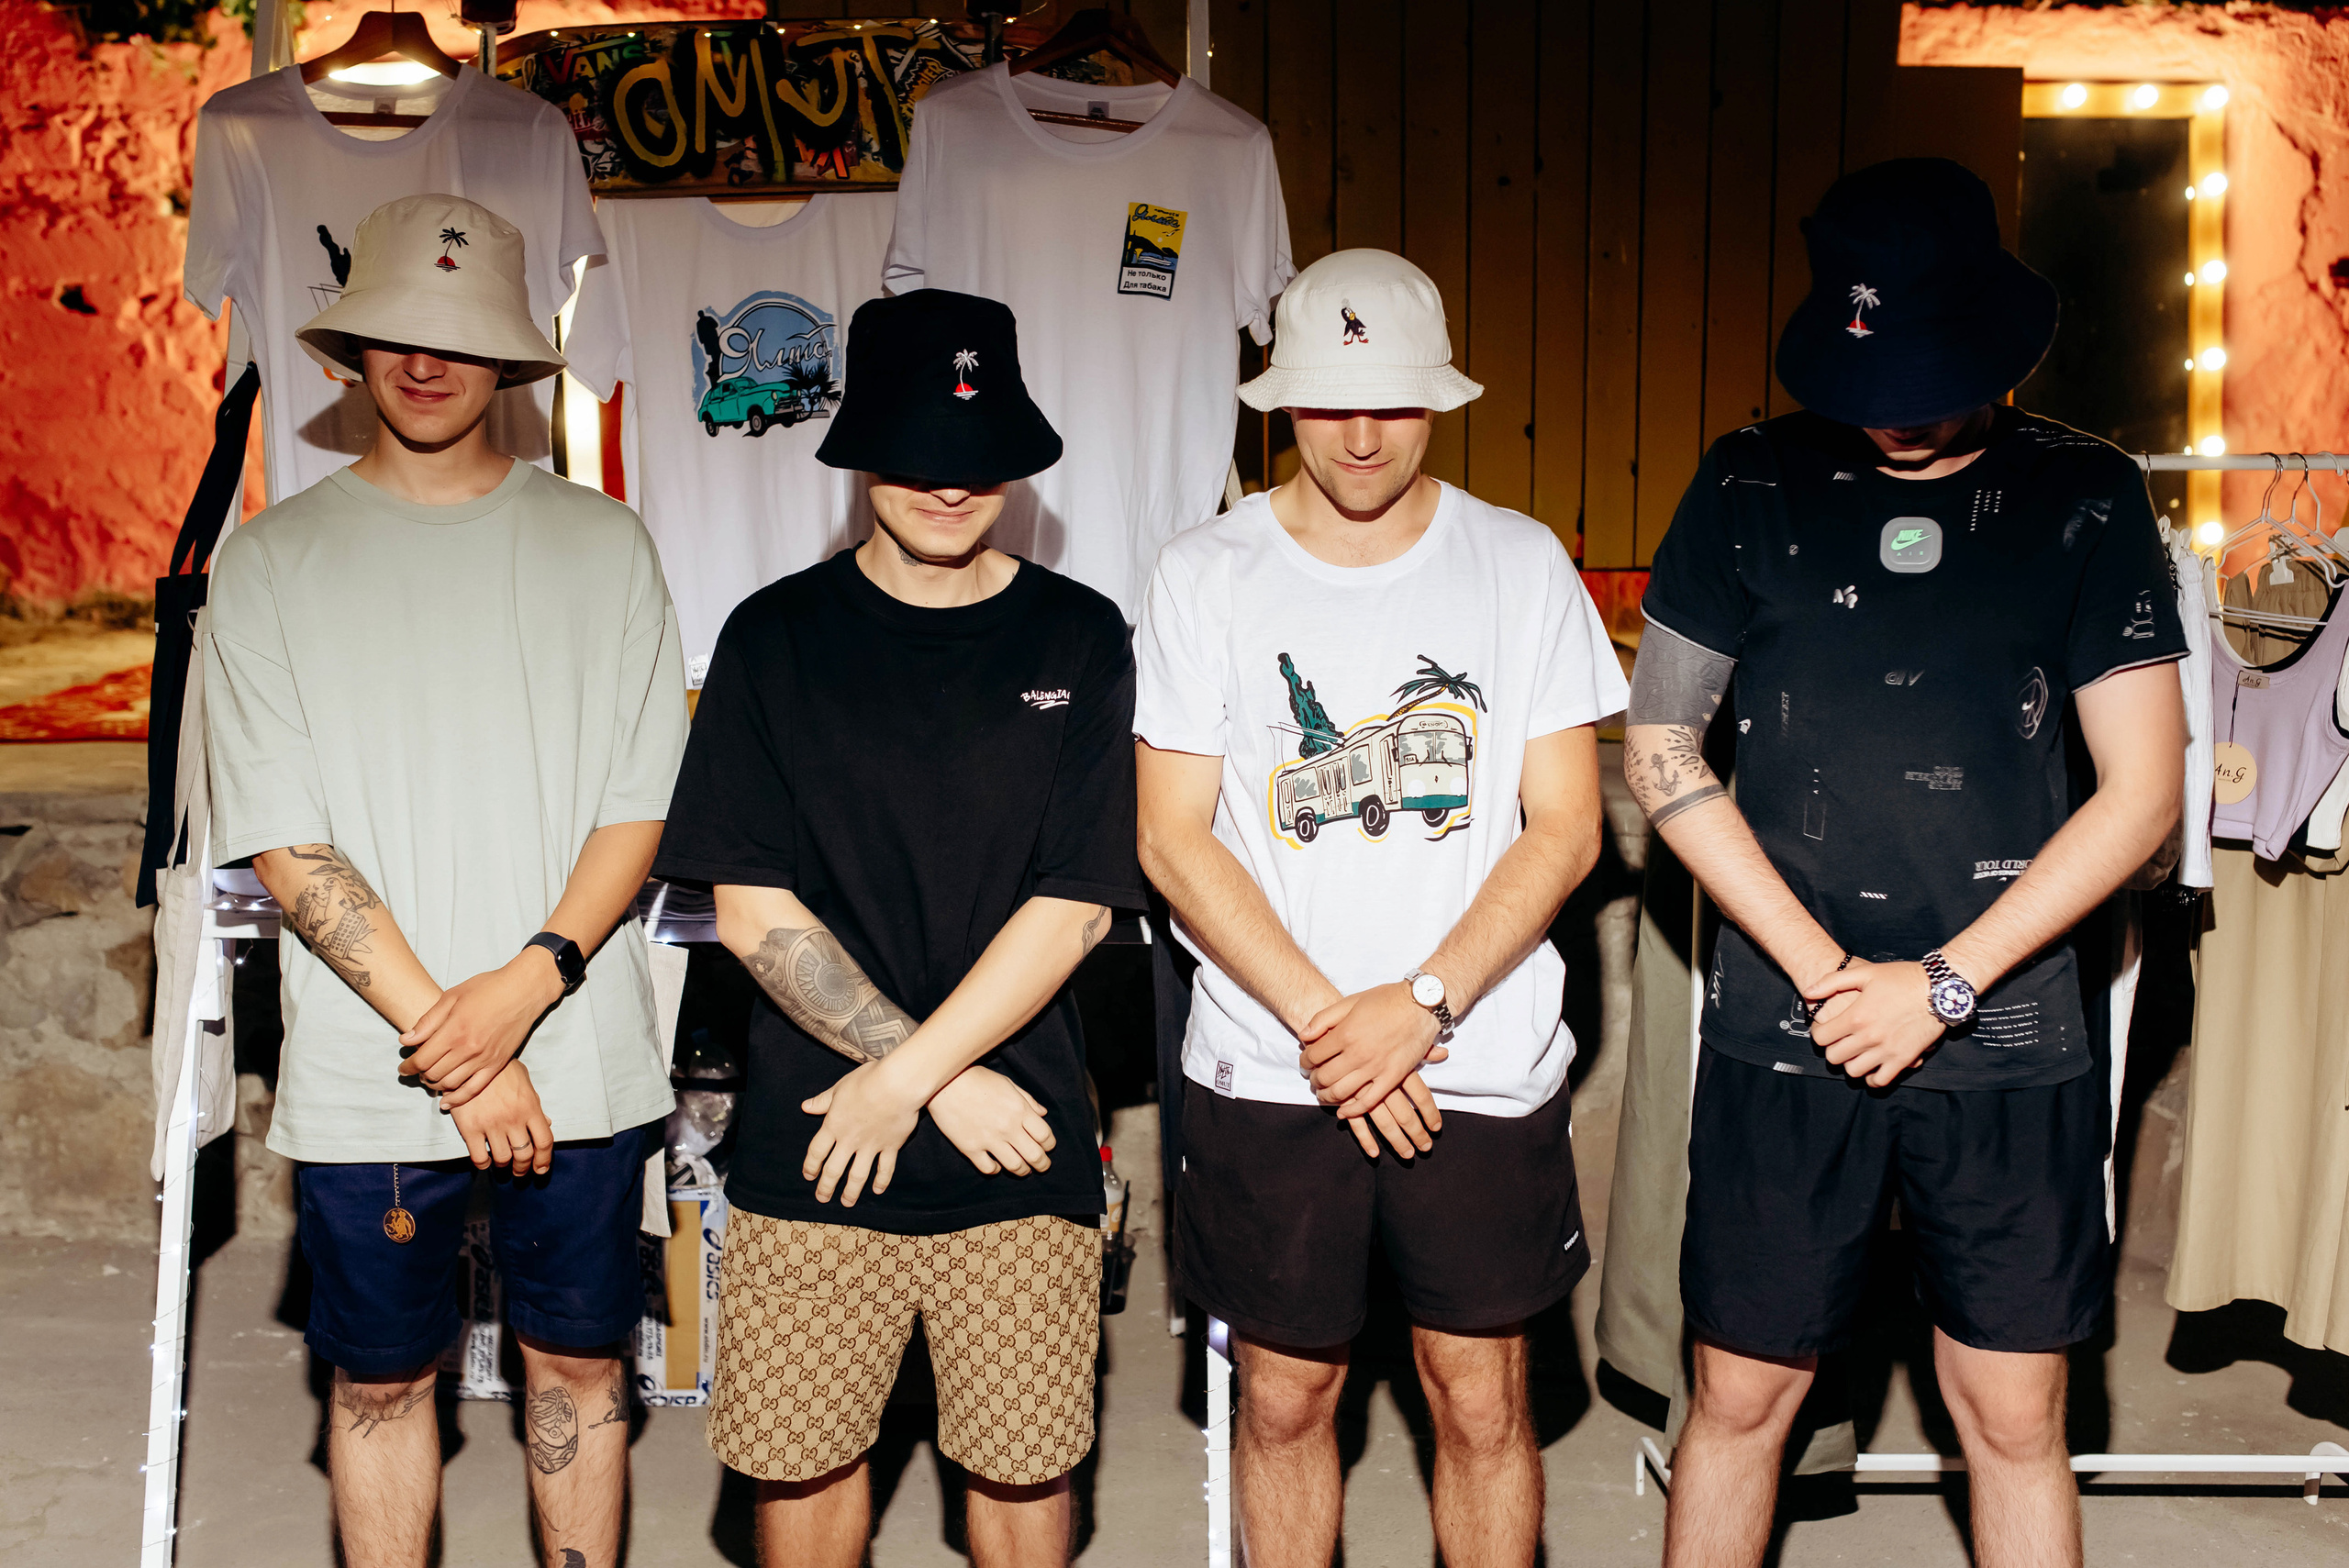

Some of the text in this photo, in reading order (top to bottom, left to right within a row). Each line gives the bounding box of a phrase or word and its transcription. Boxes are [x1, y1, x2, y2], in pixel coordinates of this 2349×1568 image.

[541, 31, 644, 85] VANS
[1123, 281, 1167, 293] Для табака
[1138, 271, 1166, 281] только
[717, 326, 832, 384] Ялта
[1974, 859, 2033, 872] ORLD TOUR
[707, 1252, 721, 1300] asics
